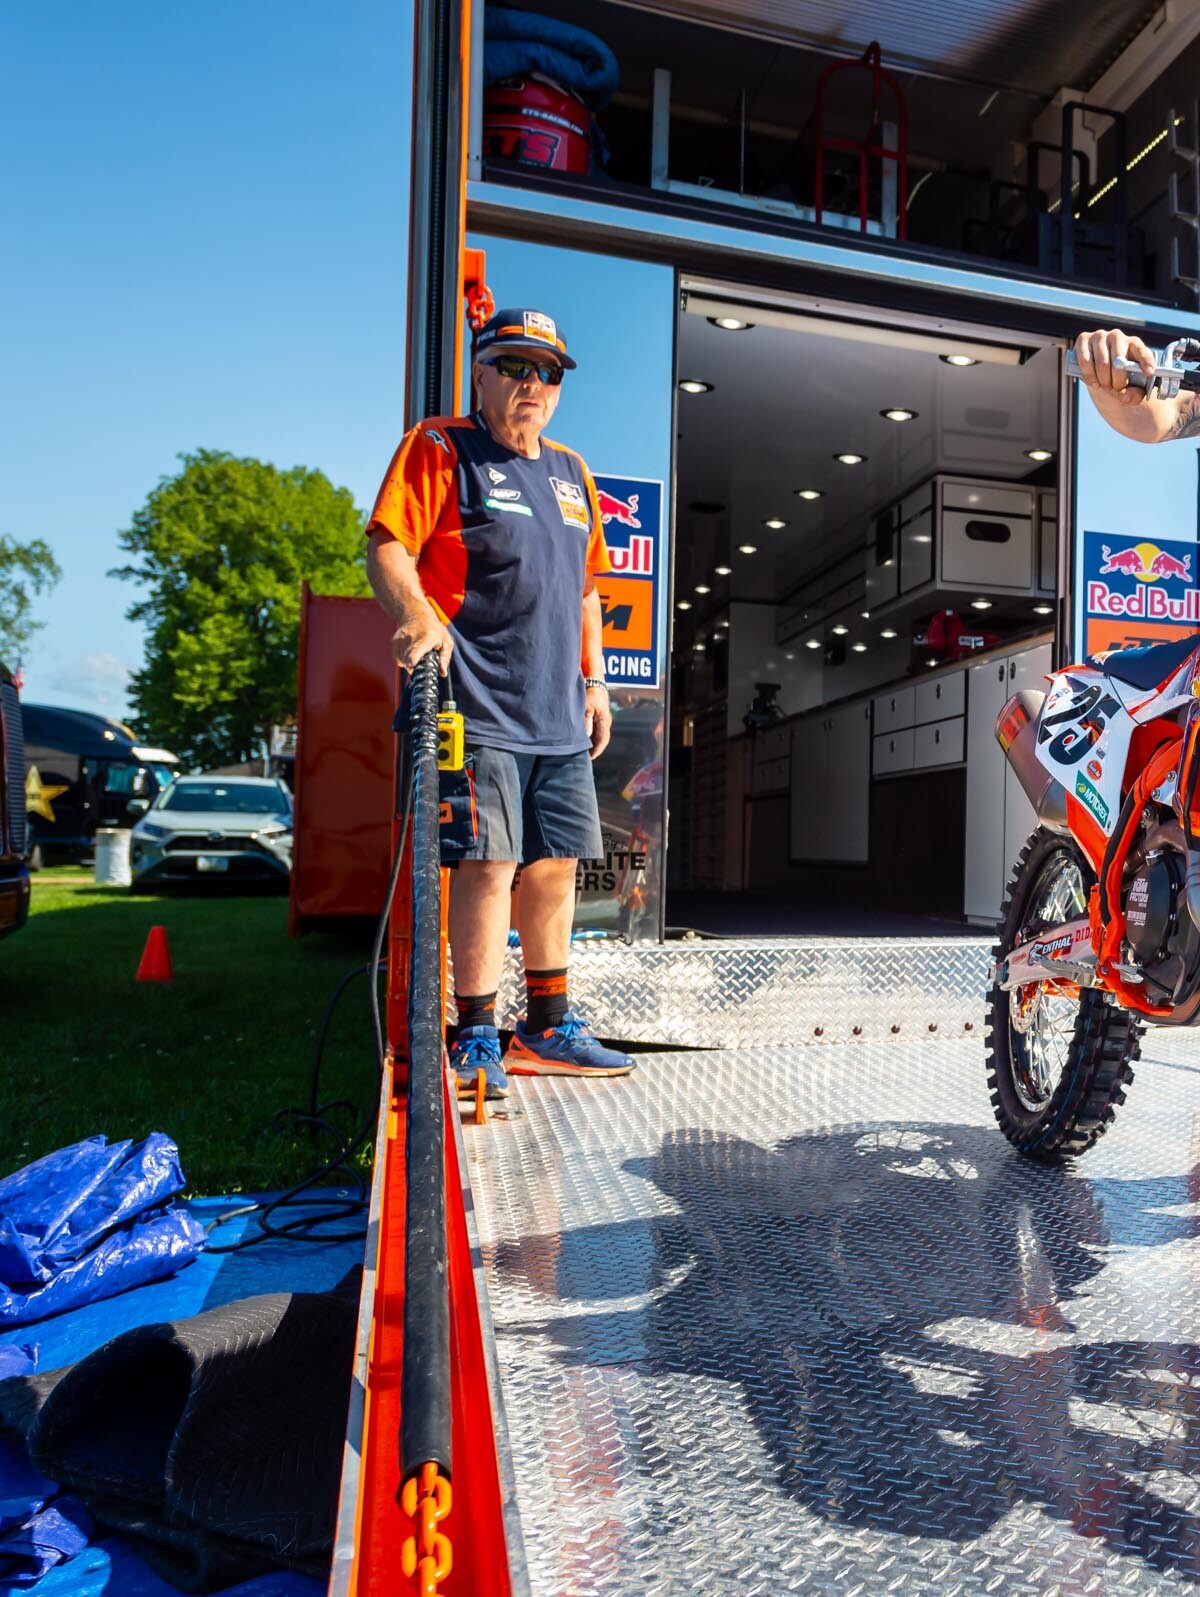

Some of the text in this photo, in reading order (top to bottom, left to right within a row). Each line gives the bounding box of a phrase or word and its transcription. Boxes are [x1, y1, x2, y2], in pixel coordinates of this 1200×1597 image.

[609, 535, 653, 574] ull
[1087, 581, 1146, 617] Red
[602, 654, 652, 677] CING
[1038, 685, 1120, 765] 25
[1084, 786, 1108, 823] MOTOREX
[582, 852, 646, 870] LITE
